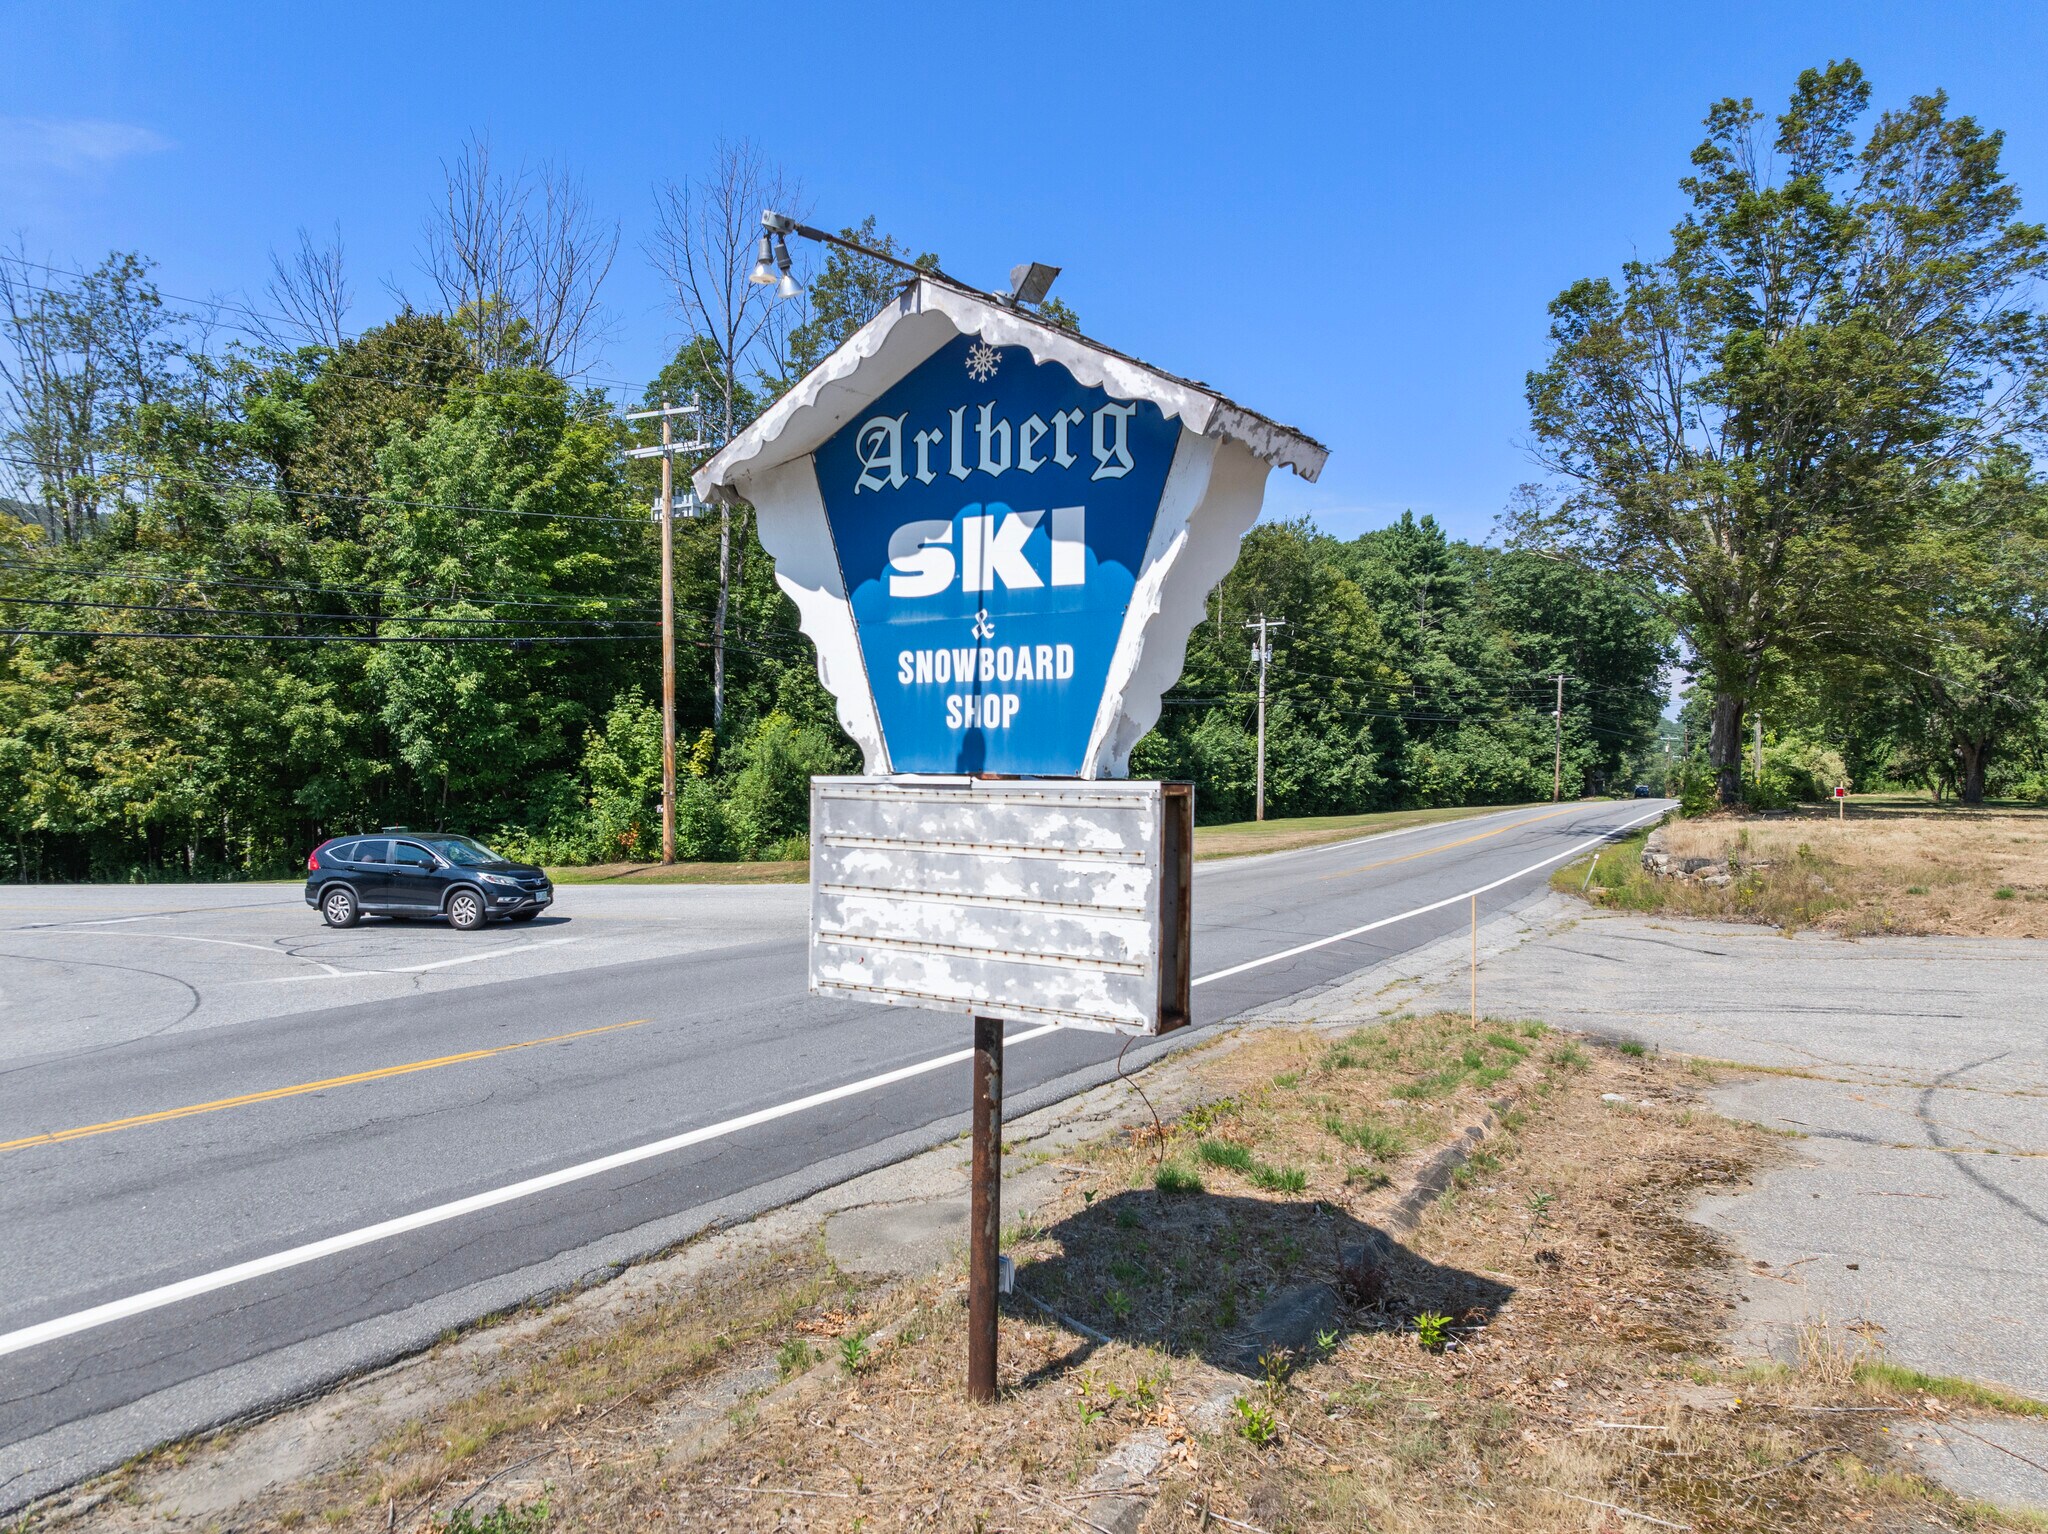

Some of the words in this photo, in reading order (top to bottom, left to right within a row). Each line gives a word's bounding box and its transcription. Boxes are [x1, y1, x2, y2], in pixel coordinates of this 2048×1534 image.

[854, 400, 1137, 495] Arlberg
[888, 506, 1086, 597] SKI
[970, 608, 995, 640] &
[897, 644, 1074, 684] SNOWBOARD
[946, 694, 1020, 729] SHOP
